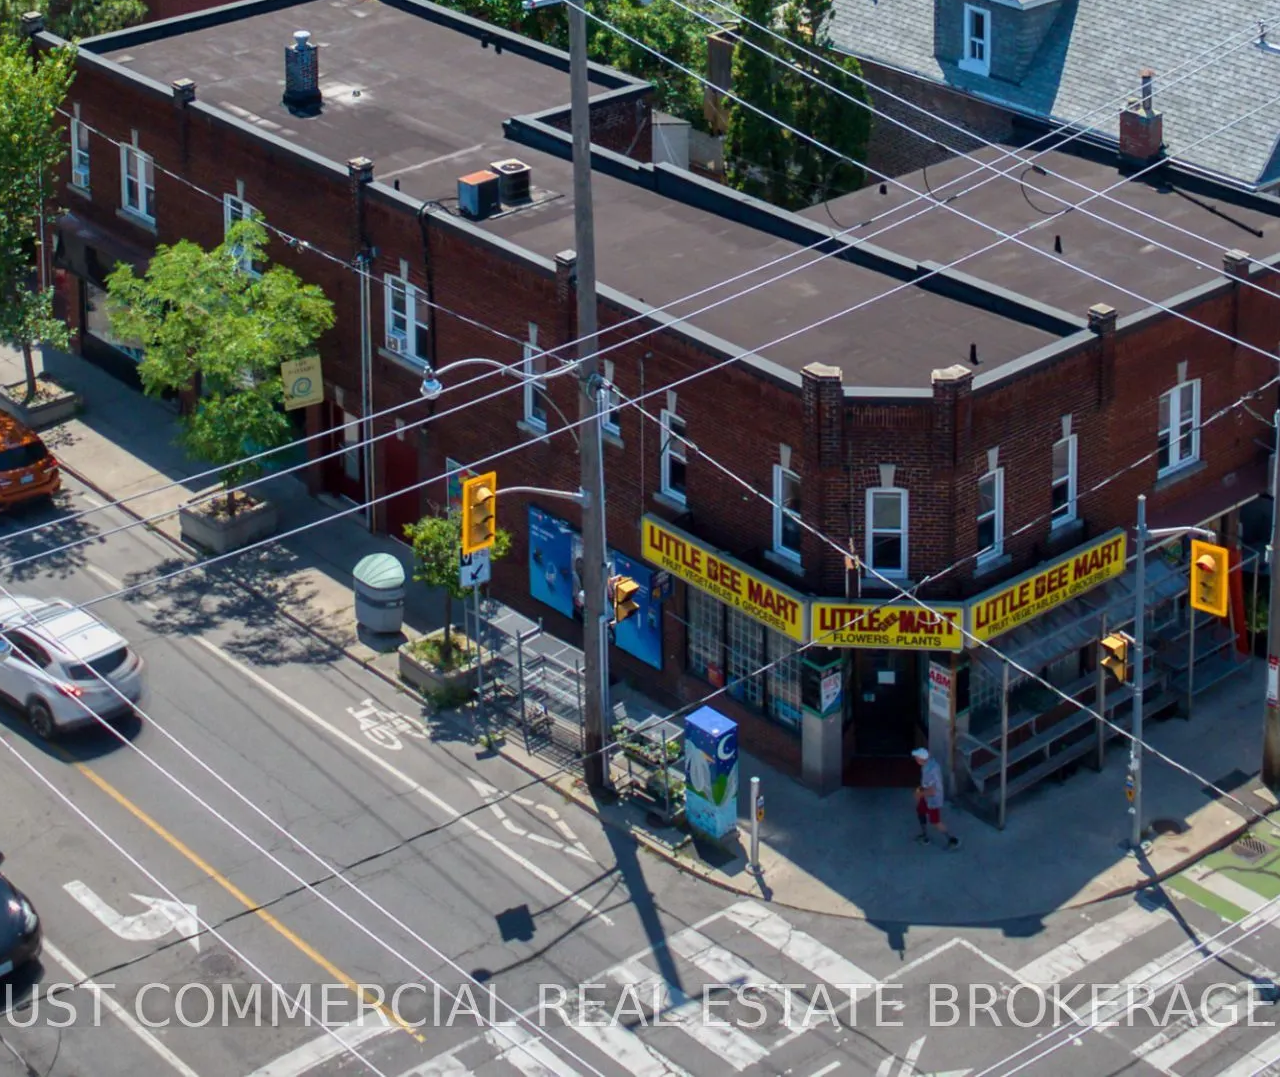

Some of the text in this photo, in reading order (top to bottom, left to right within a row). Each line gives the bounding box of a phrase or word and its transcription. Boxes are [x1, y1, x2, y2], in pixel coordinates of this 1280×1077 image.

[650, 524, 799, 625] LITTLE BEE MART
[975, 538, 1122, 631] LITTLE BEE MART
[742, 601, 786, 631] GROCERIES
[820, 608, 881, 632] LITTLE
[898, 610, 957, 635] MART
[833, 633, 942, 646] FLOWERS PLANTS
[928, 670, 951, 689] ABM
